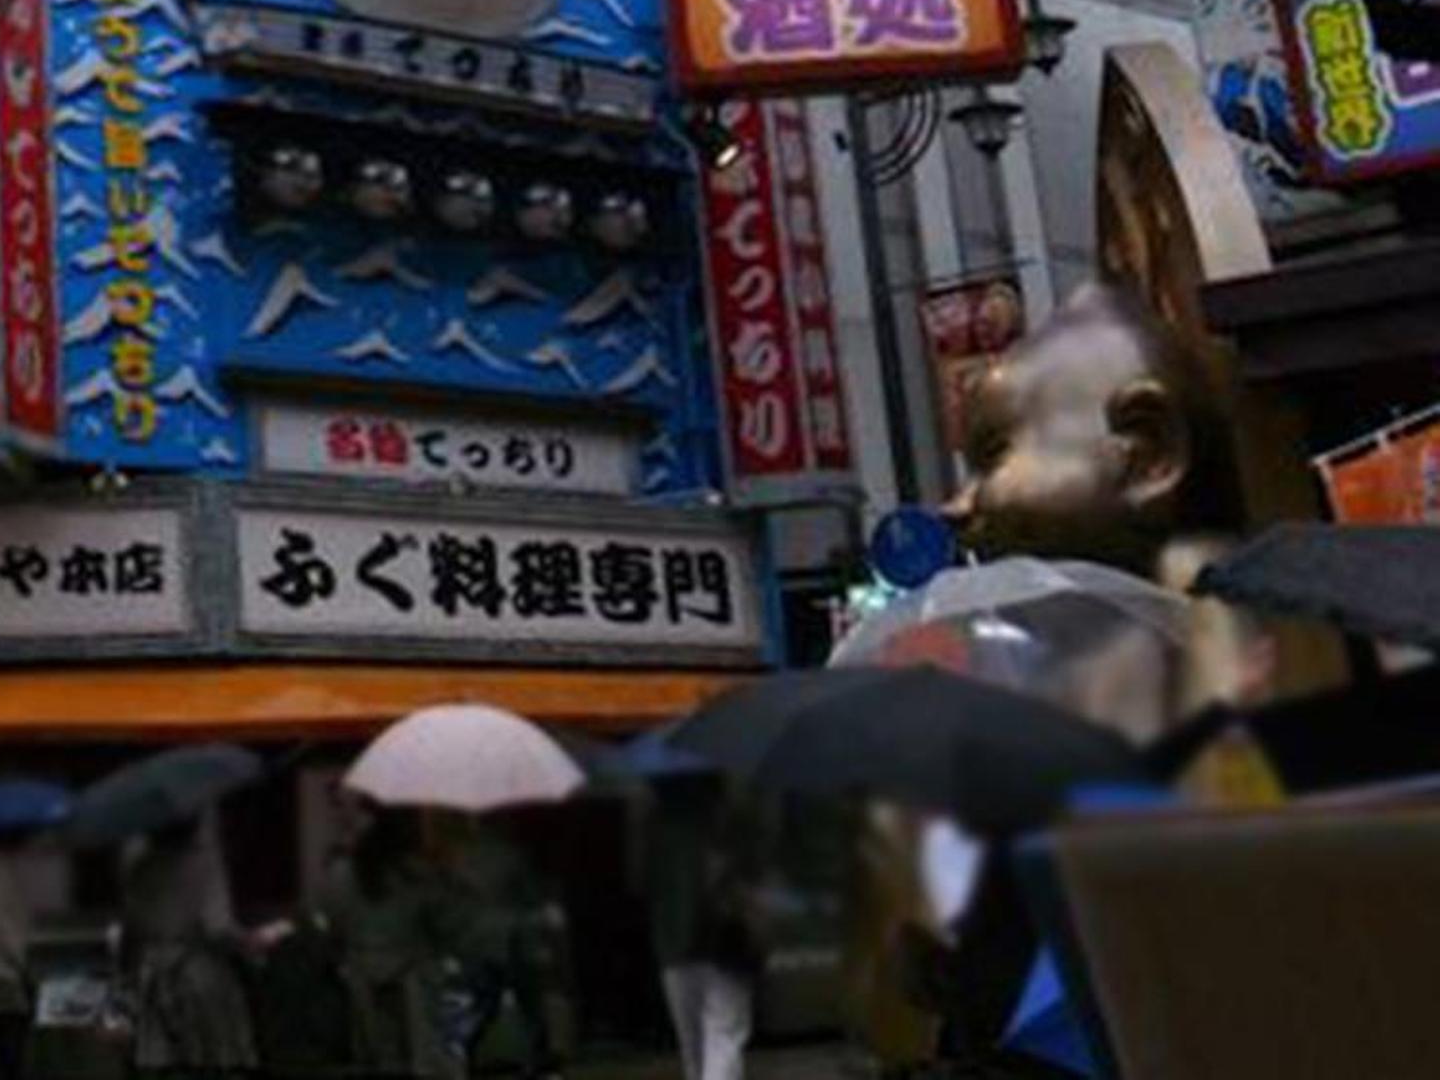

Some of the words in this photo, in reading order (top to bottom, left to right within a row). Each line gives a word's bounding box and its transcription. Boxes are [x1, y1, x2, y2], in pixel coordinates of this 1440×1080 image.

[261, 528, 733, 625] ふぐ料理専門
